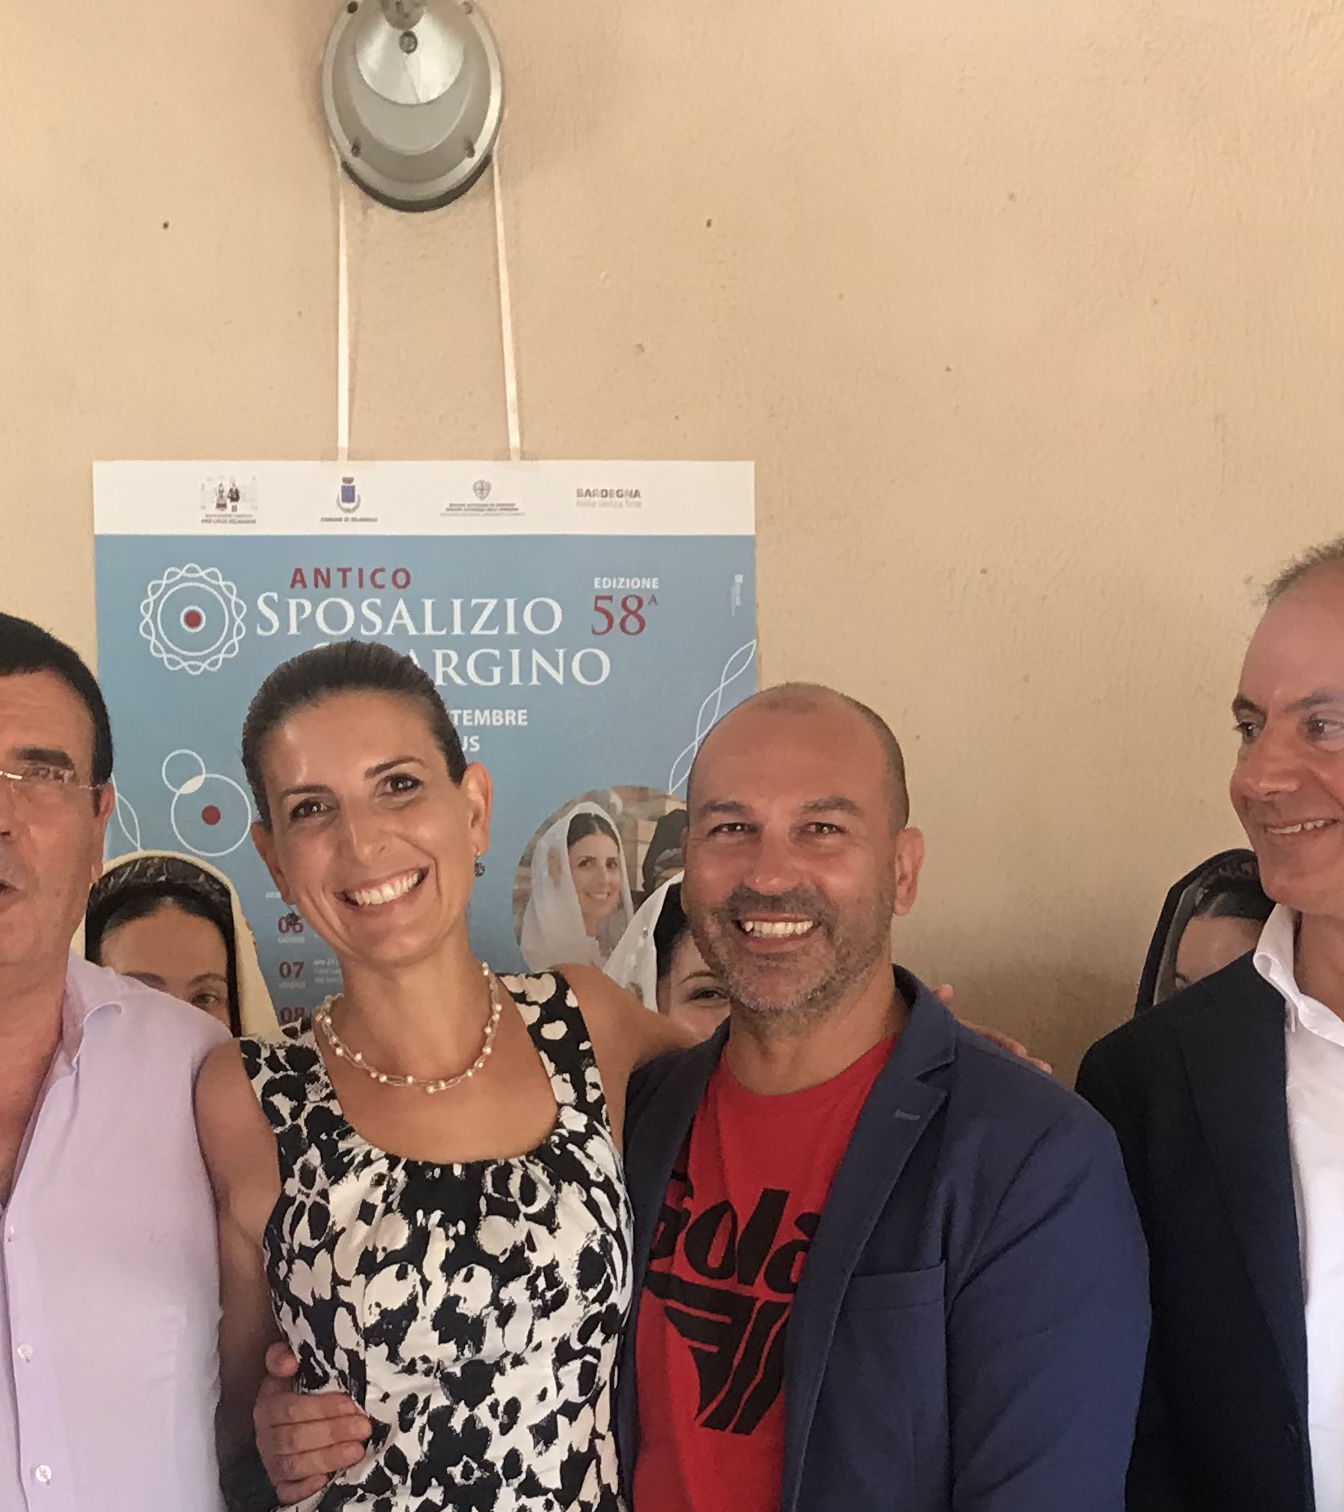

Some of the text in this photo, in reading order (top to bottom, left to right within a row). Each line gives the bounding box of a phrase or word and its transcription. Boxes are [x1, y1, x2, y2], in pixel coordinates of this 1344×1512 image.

[576, 488, 641, 498] SARDEGNA
[290, 567, 412, 589] ANTICO
[594, 577, 659, 589] EDIZIONE
[256, 591, 563, 636] SPOSALIZIO
[408, 647, 611, 687] RGINO
[451, 709, 528, 727] TEMBRE
[279, 961, 305, 979] 07
